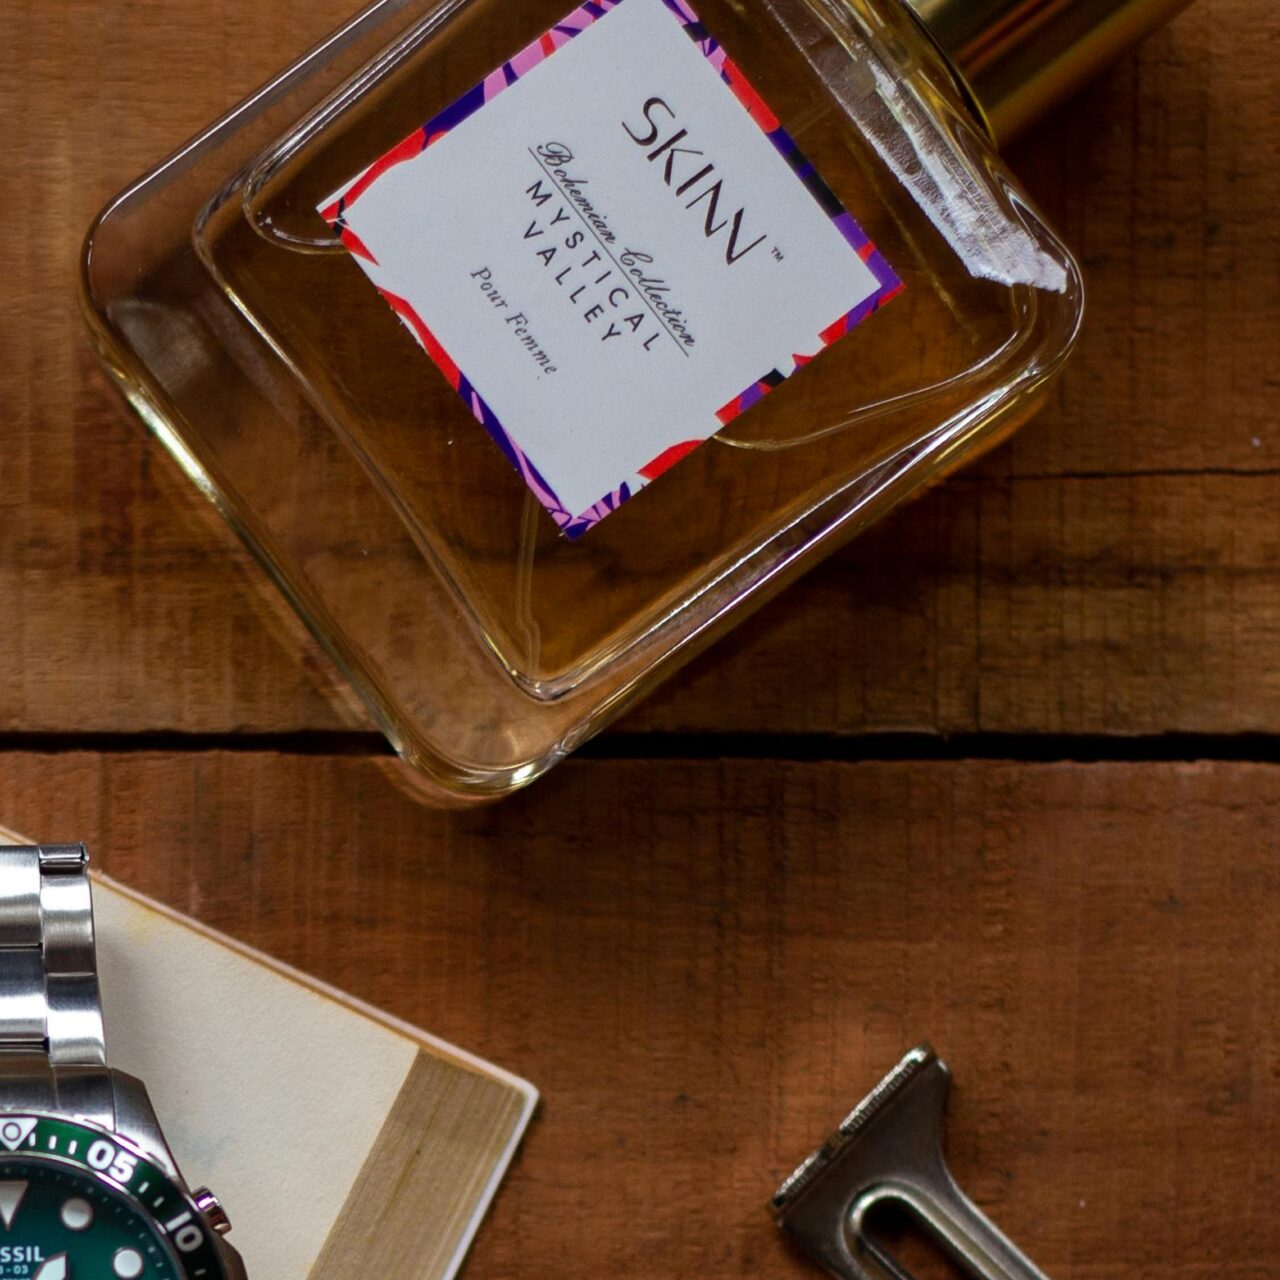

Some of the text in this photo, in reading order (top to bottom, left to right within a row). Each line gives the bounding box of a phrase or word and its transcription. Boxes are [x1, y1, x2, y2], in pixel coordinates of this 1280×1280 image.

[622, 97, 766, 266] SKINN
[523, 220, 622, 342] VALLEY
[525, 180, 656, 352] MYSTICAL
[536, 140, 696, 349] Bohemian Collection
[470, 265, 558, 376] Pour Femme
[87, 1140, 138, 1184] 05
[165, 1211, 204, 1251] 10
